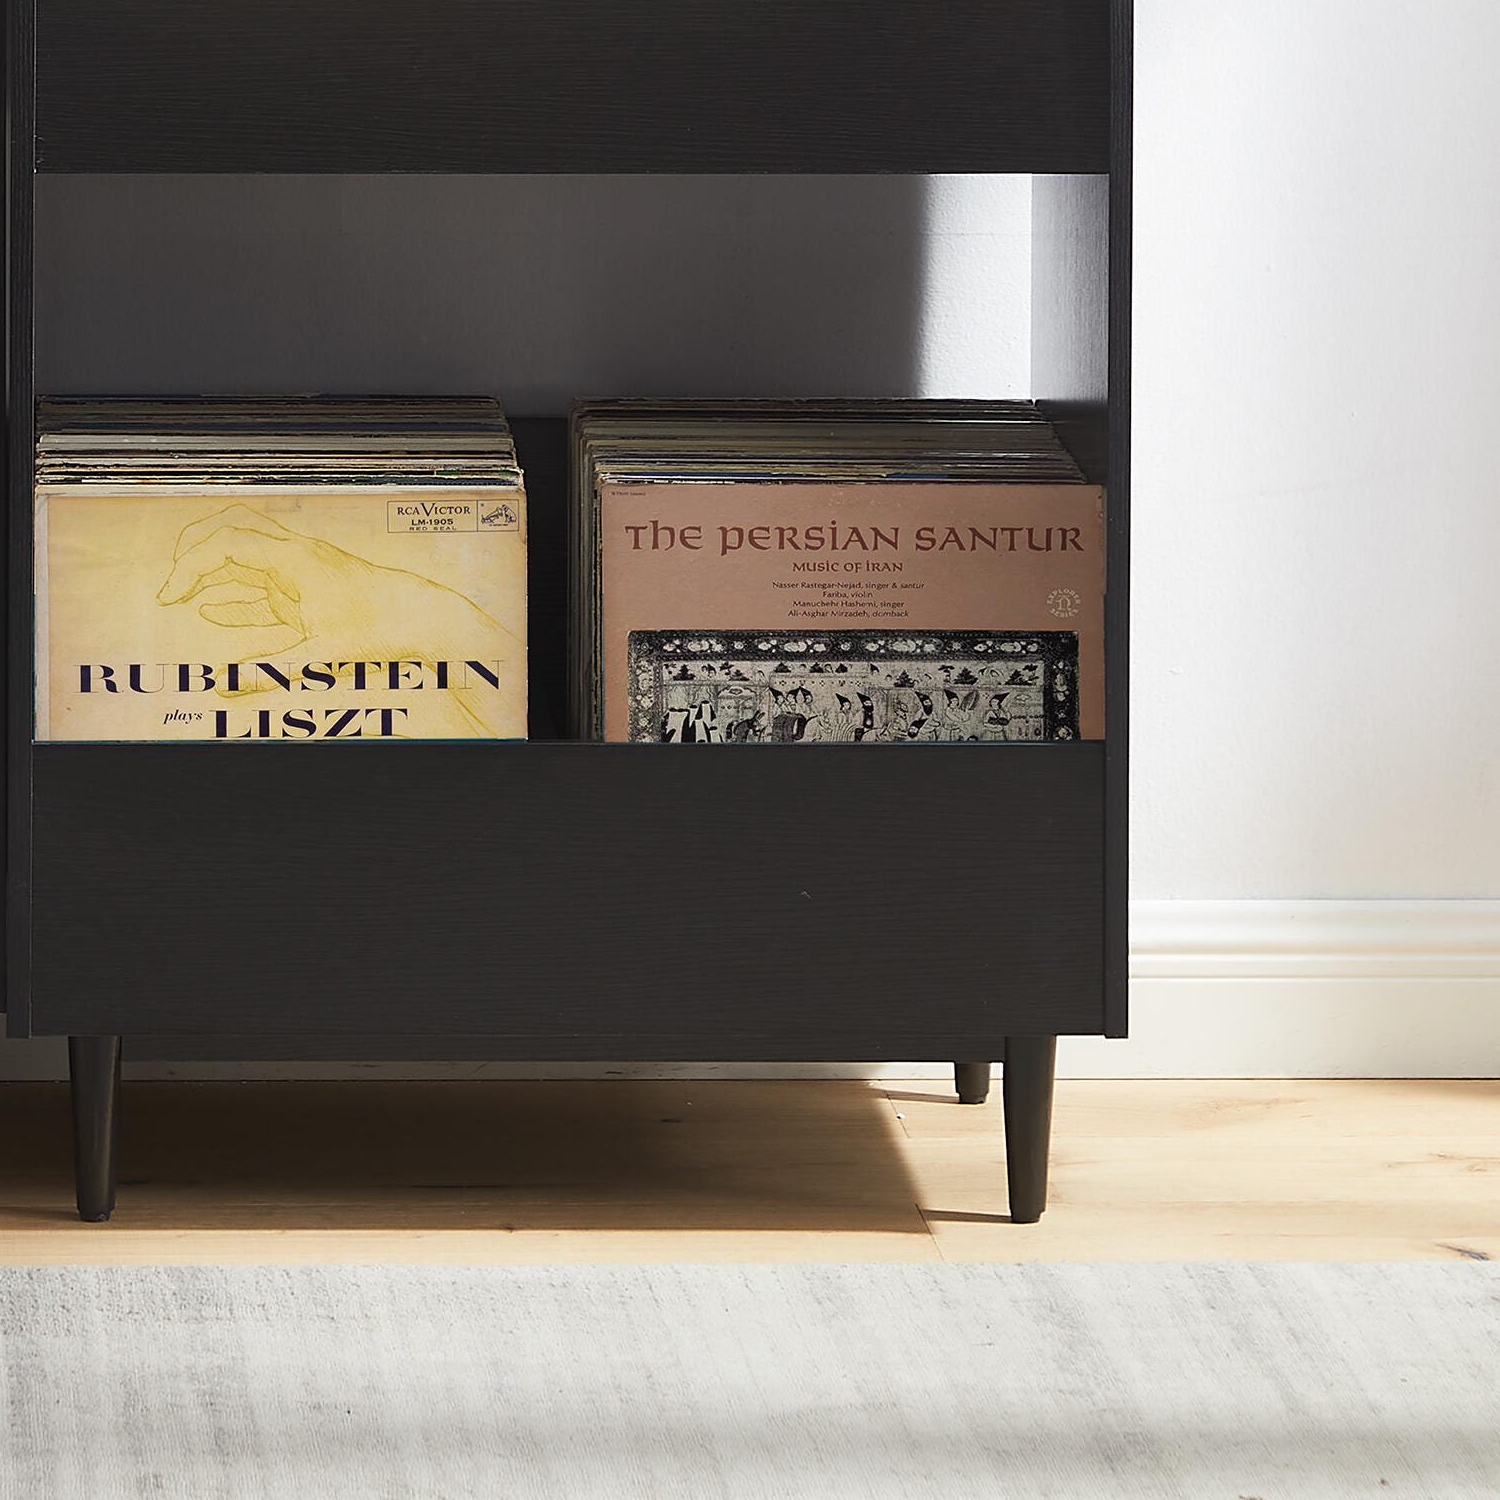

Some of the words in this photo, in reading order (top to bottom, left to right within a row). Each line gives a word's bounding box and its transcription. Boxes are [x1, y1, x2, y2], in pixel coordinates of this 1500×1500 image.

[397, 507, 419, 515] RCA
[915, 525, 1085, 552] SANTUR
[792, 560, 839, 572] MUSIC
[844, 562, 862, 573] OF
[865, 582, 889, 590] singer
[823, 591, 849, 599] Fariba,
[73, 661, 506, 693] RUBINSTEIN
[163, 709, 203, 724] plays
[209, 708, 409, 738] LISZT
